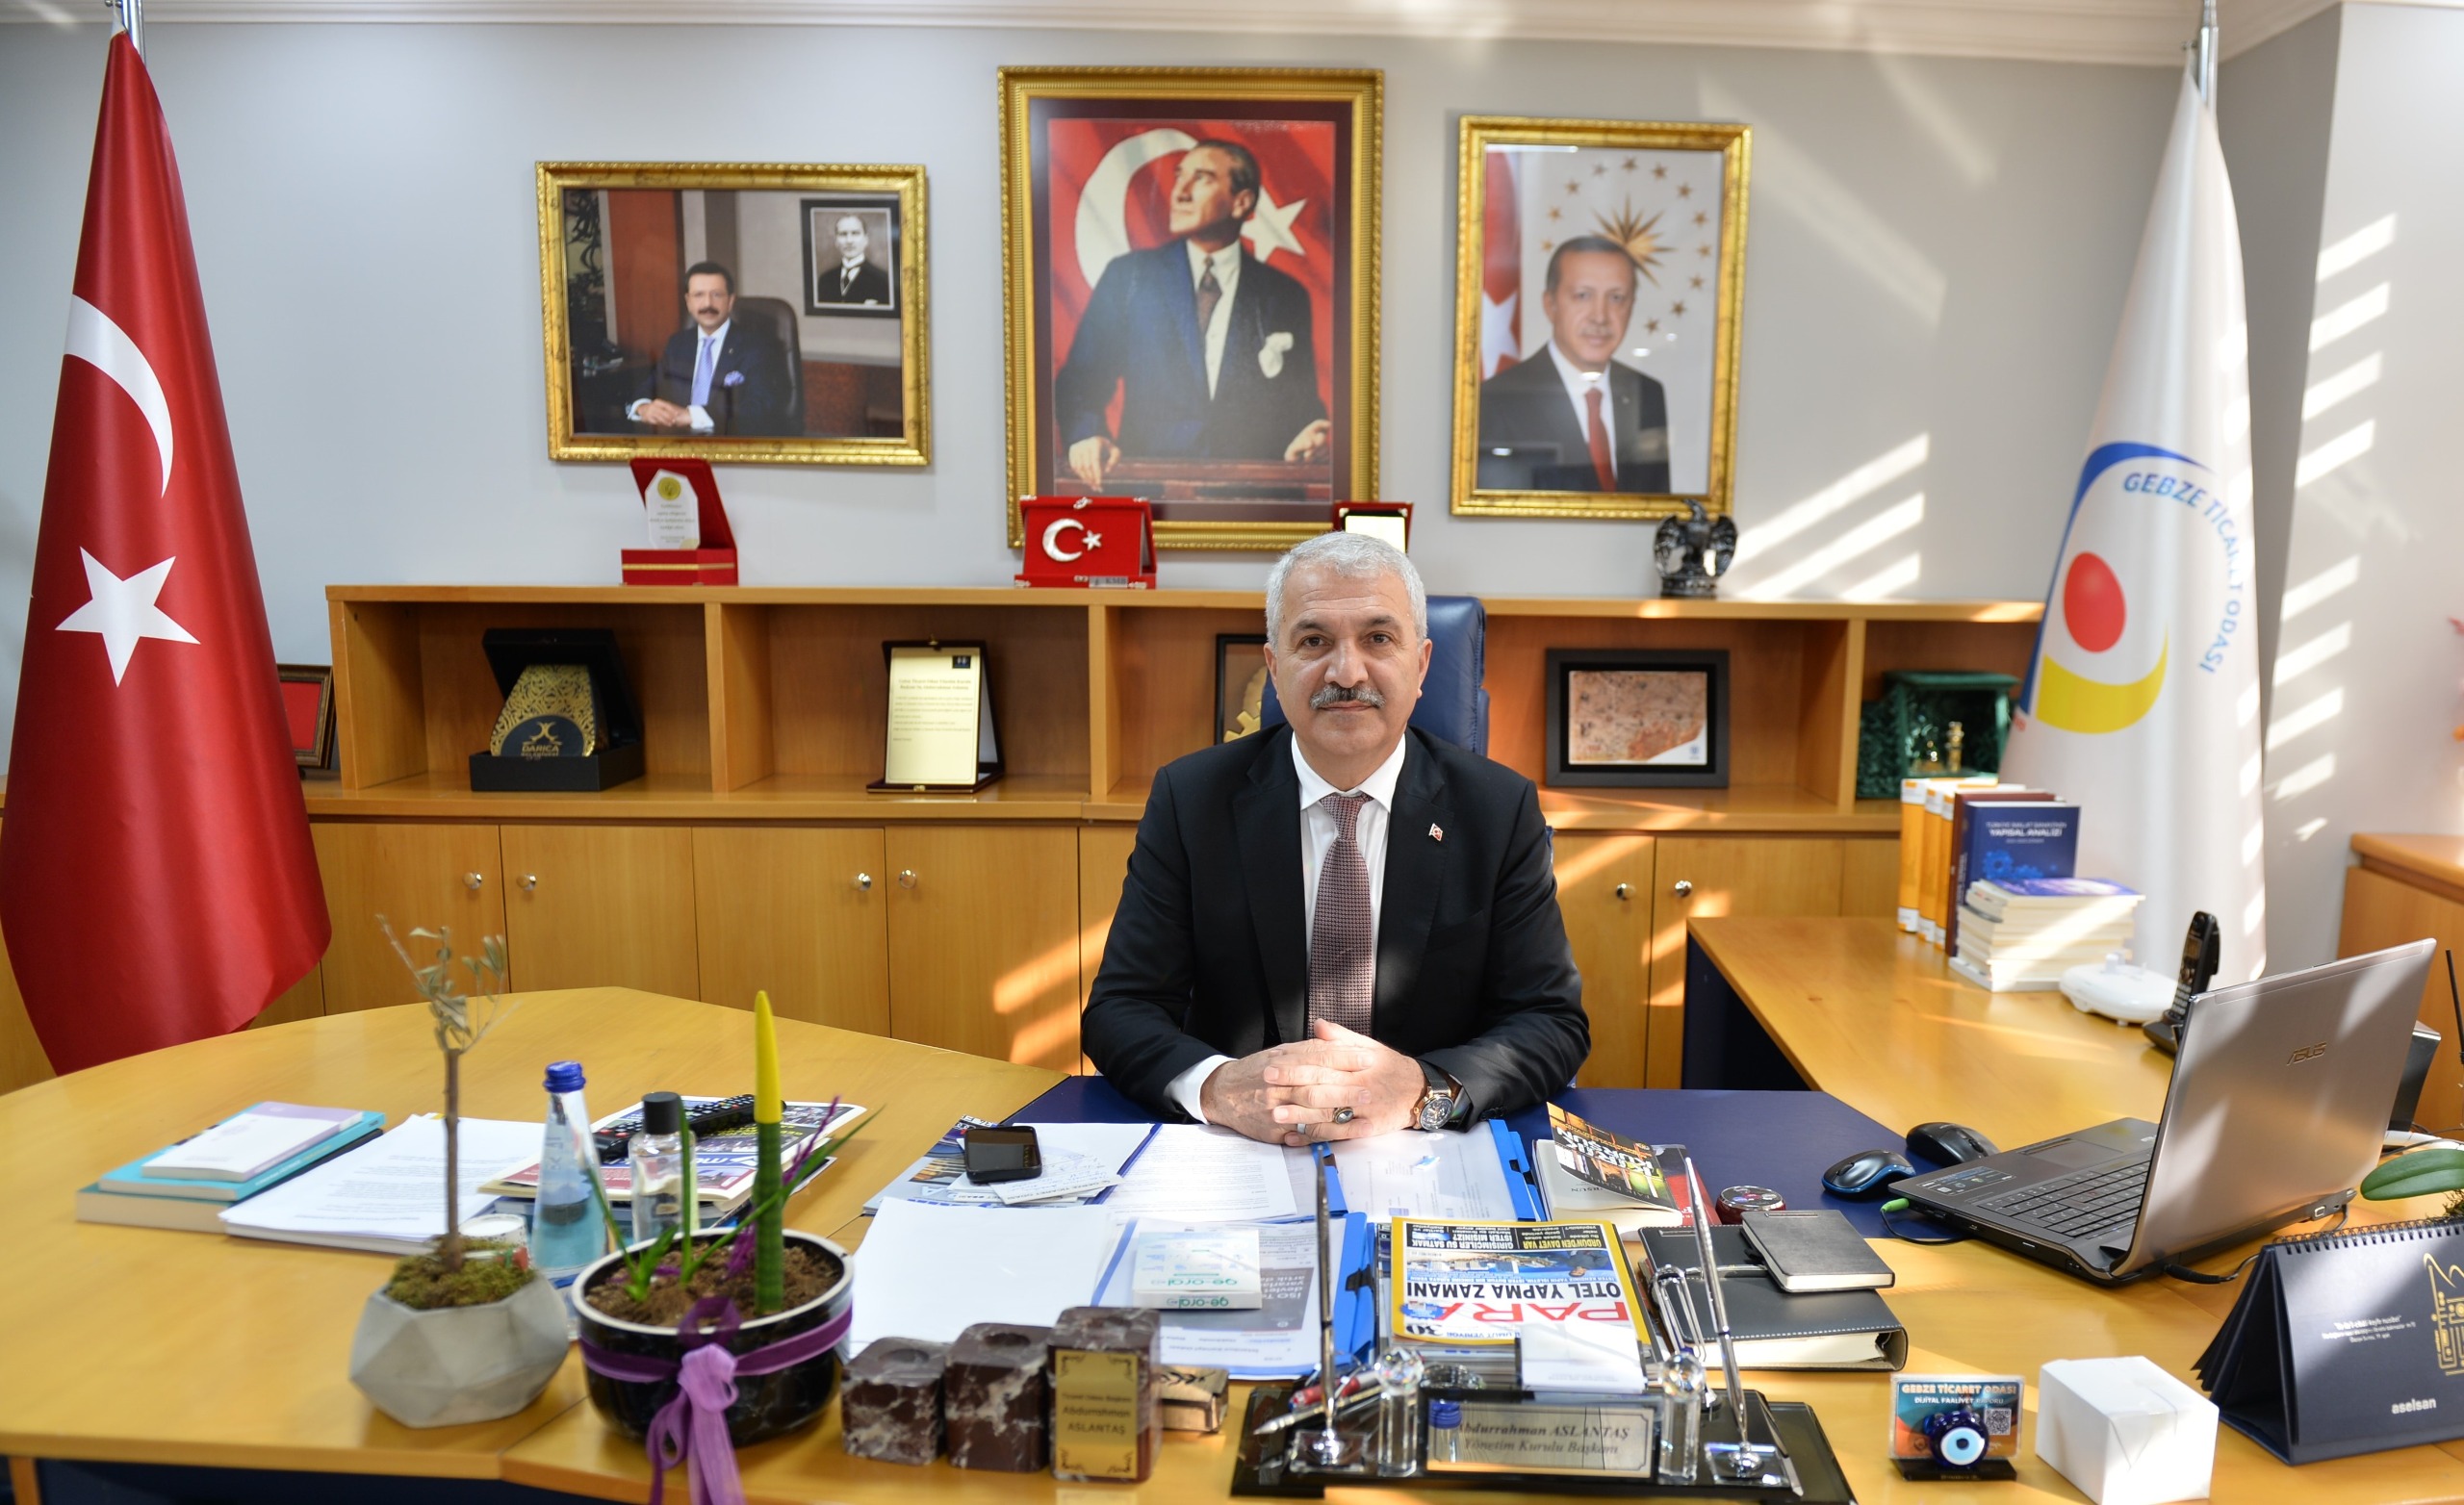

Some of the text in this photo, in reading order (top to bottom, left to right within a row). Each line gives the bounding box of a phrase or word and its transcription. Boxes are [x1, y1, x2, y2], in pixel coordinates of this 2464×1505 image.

[2123, 472, 2208, 508] GEBZE
[2198, 599, 2242, 674] ODASI
[2286, 1041, 2327, 1066] ASUS
[1523, 1238, 1603, 1249] ÜRDÜN'DEN DAVET VAR
[1407, 1282, 1622, 1299] OTEL YAPMA ZAMANI
[1178, 1295, 1229, 1309] ge-oral
[1434, 1302, 1630, 1322] PARA
[1901, 1383, 2017, 1394] GEBZE TİCARET ODASI
[1913, 1395, 1940, 1404] DİJİTAL
[2391, 1397, 2437, 1415] aselsan
[1063, 1407, 1131, 1417] Abdurrahman
[1067, 1423, 1126, 1435] ASLANTAŞ
[1550, 1425, 1630, 1441] ASLANTAŞ
[1465, 1439, 1515, 1452] Yönetim
[1518, 1441, 1564, 1453] Kurulu
